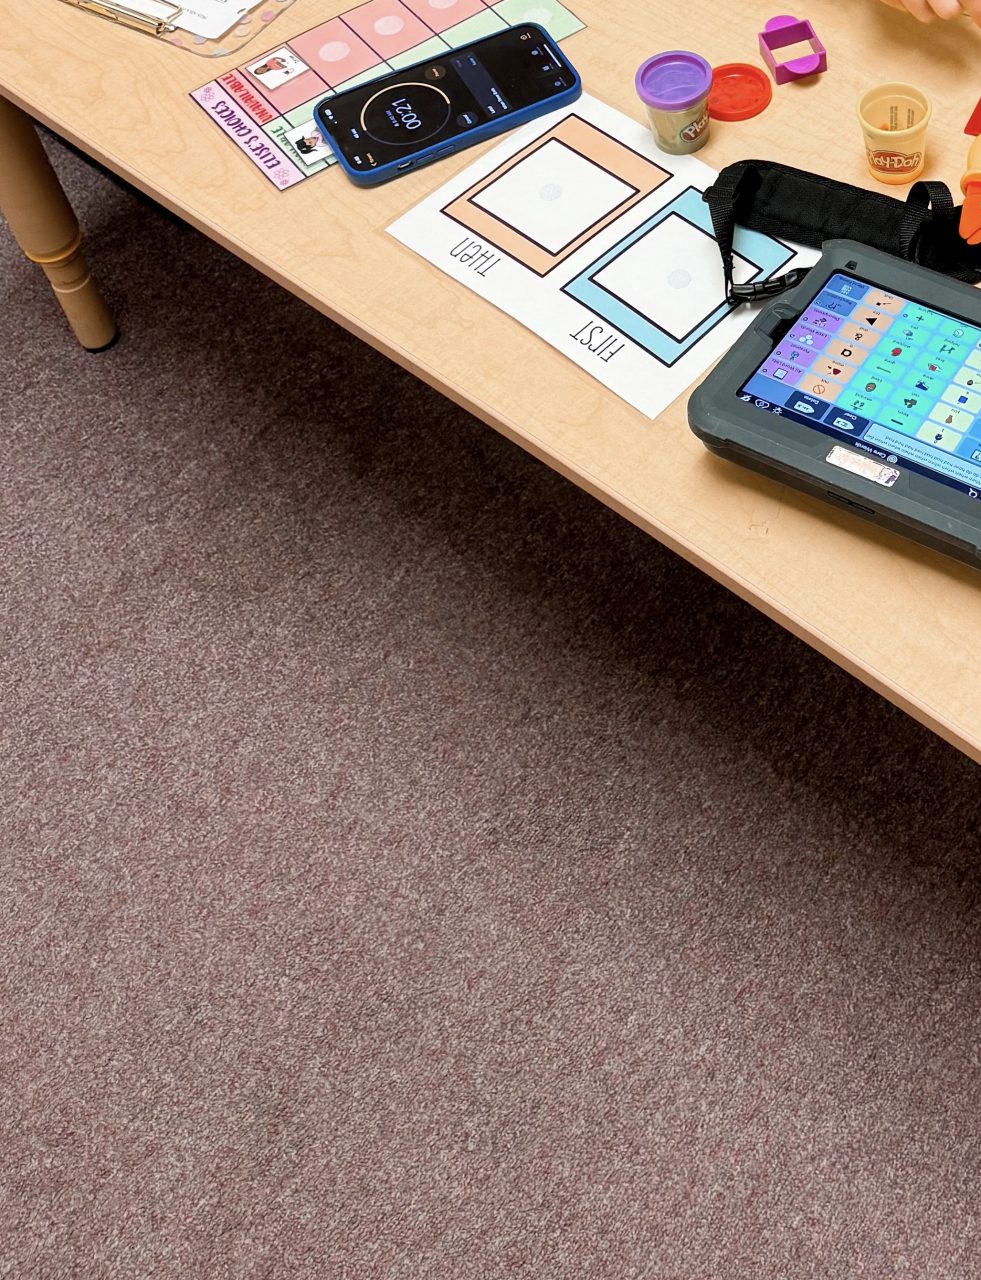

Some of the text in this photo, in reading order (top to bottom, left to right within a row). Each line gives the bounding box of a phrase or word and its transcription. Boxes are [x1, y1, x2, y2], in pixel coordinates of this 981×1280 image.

[220, 73, 272, 123] UNAVAILABLE
[390, 97, 423, 130] 00:21
[210, 100, 281, 169] ELISE'S CHOICES
[802, 395, 819, 404] Delete
[843, 411, 857, 420] Clear
[854, 440, 886, 458] Core Words
